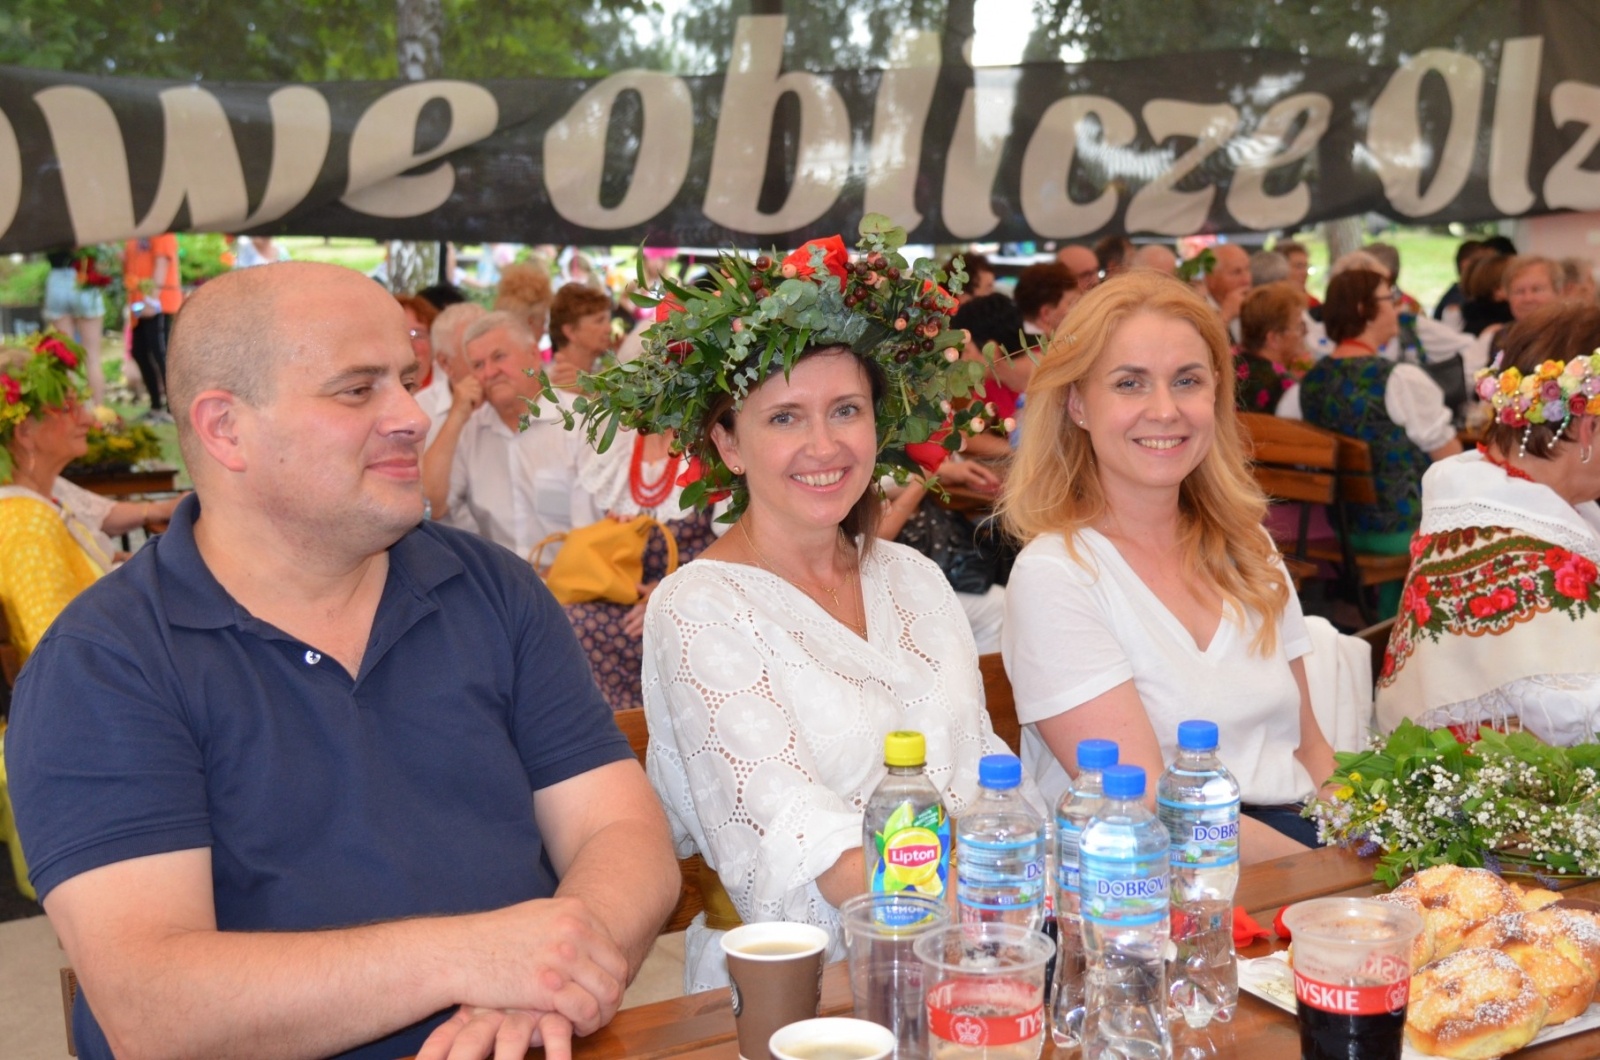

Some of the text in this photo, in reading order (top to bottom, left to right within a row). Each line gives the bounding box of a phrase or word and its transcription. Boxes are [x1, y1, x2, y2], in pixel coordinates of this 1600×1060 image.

[0, 80, 498, 245] we
[543, 14, 1332, 240] oblicze
[891, 848, 935, 865] Lipton
[1295, 974, 1359, 1011] TYSKIE
